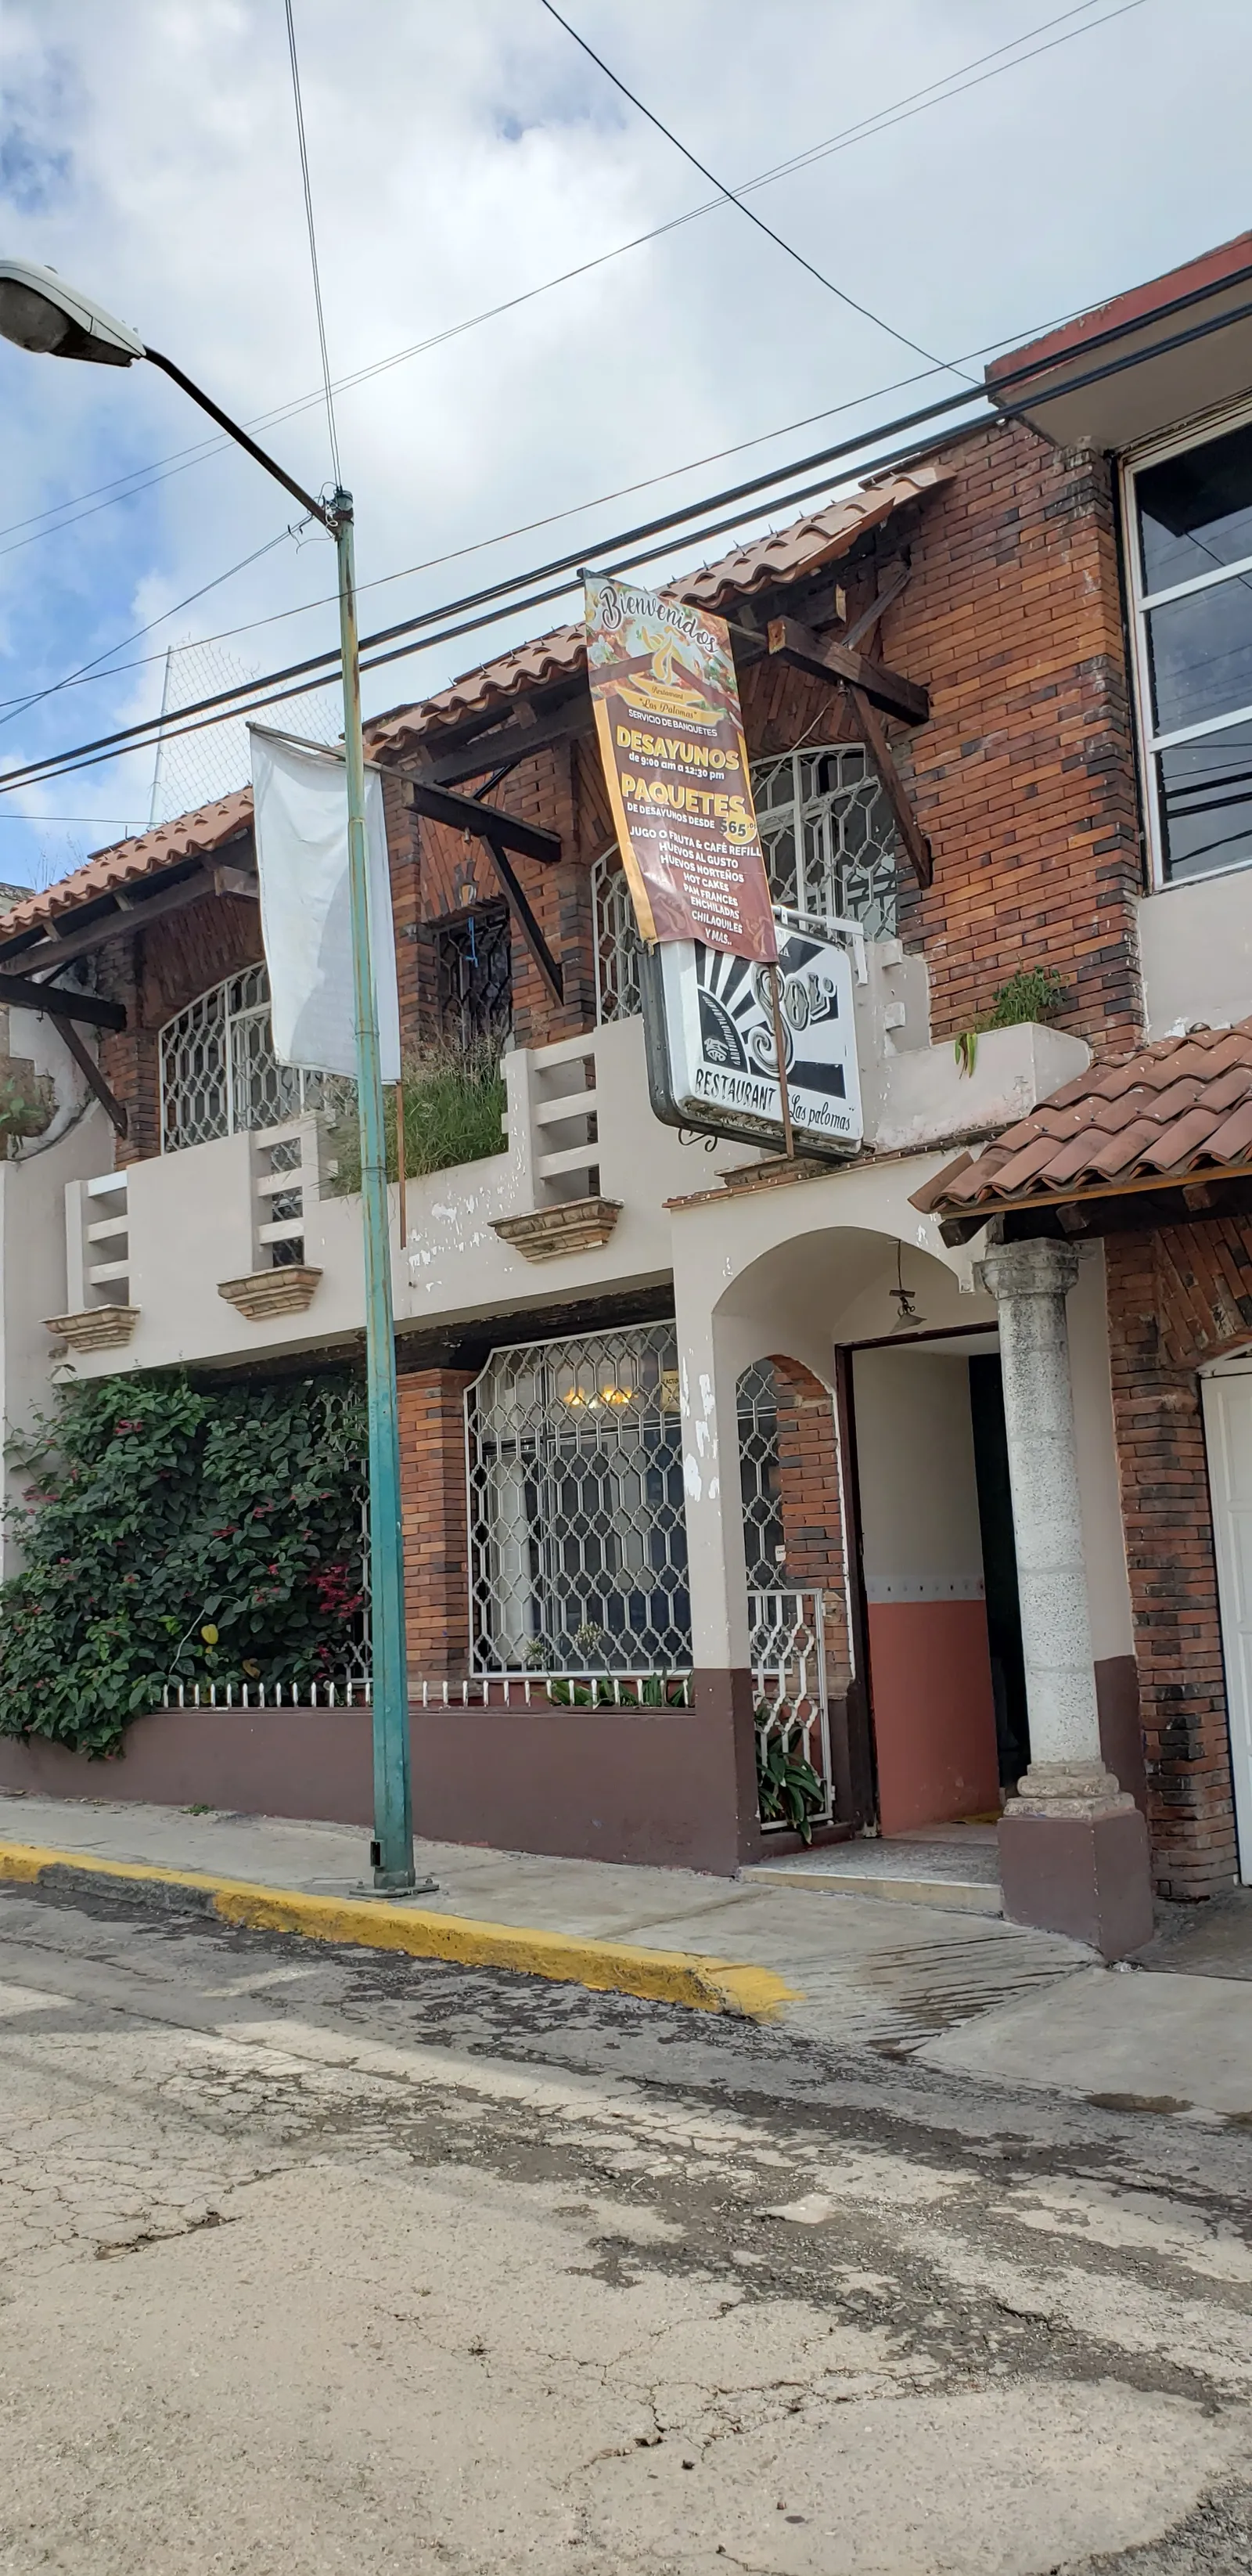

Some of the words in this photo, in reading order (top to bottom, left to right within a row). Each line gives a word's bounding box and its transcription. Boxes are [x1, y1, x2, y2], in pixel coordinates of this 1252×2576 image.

[599, 586, 718, 653] Bienvenidos
[628, 709, 660, 725] SERVICIO
[662, 719, 673, 728] DE
[673, 721, 718, 737] BANQUETES
[617, 725, 739, 770] DESAYUNOS
[629, 752, 639, 762] de
[641, 757, 659, 767] 9:00
[660, 762, 676, 771] am
[685, 766, 708, 777] 12:30
[709, 771, 725, 780] pm
[621, 773, 745, 818] PAQUETES
[627, 802, 638, 812] DE
[639, 805, 687, 823] DESAYUNOS
[689, 816, 714, 829] DESDE
[630, 826, 657, 838] JUGO
[659, 830, 667, 838] O
[669, 831, 695, 848] FRUTA
[696, 840, 703, 849] &
[704, 841, 728, 854] CAFÉ
[729, 845, 761, 857] REFILL
[659, 842, 694, 859] HUEVOS
[695, 852, 706, 863] AL
[707, 856, 739, 869] GUSTO
[660, 855, 696, 872] HUEVOS
[697, 865, 744, 883] NORTEÑOS
[683, 872, 700, 884] HOT
[701, 878, 729, 892] CAKES
[683, 883, 700, 896] PAN
[700, 889, 739, 907] FRANCES
[690, 896, 739, 920] ENCHILADAS
[692, 910, 743, 935] CHILAQUILES
[705, 928, 711, 939] Y
[695, 1068, 777, 1111] RESTAURANT
